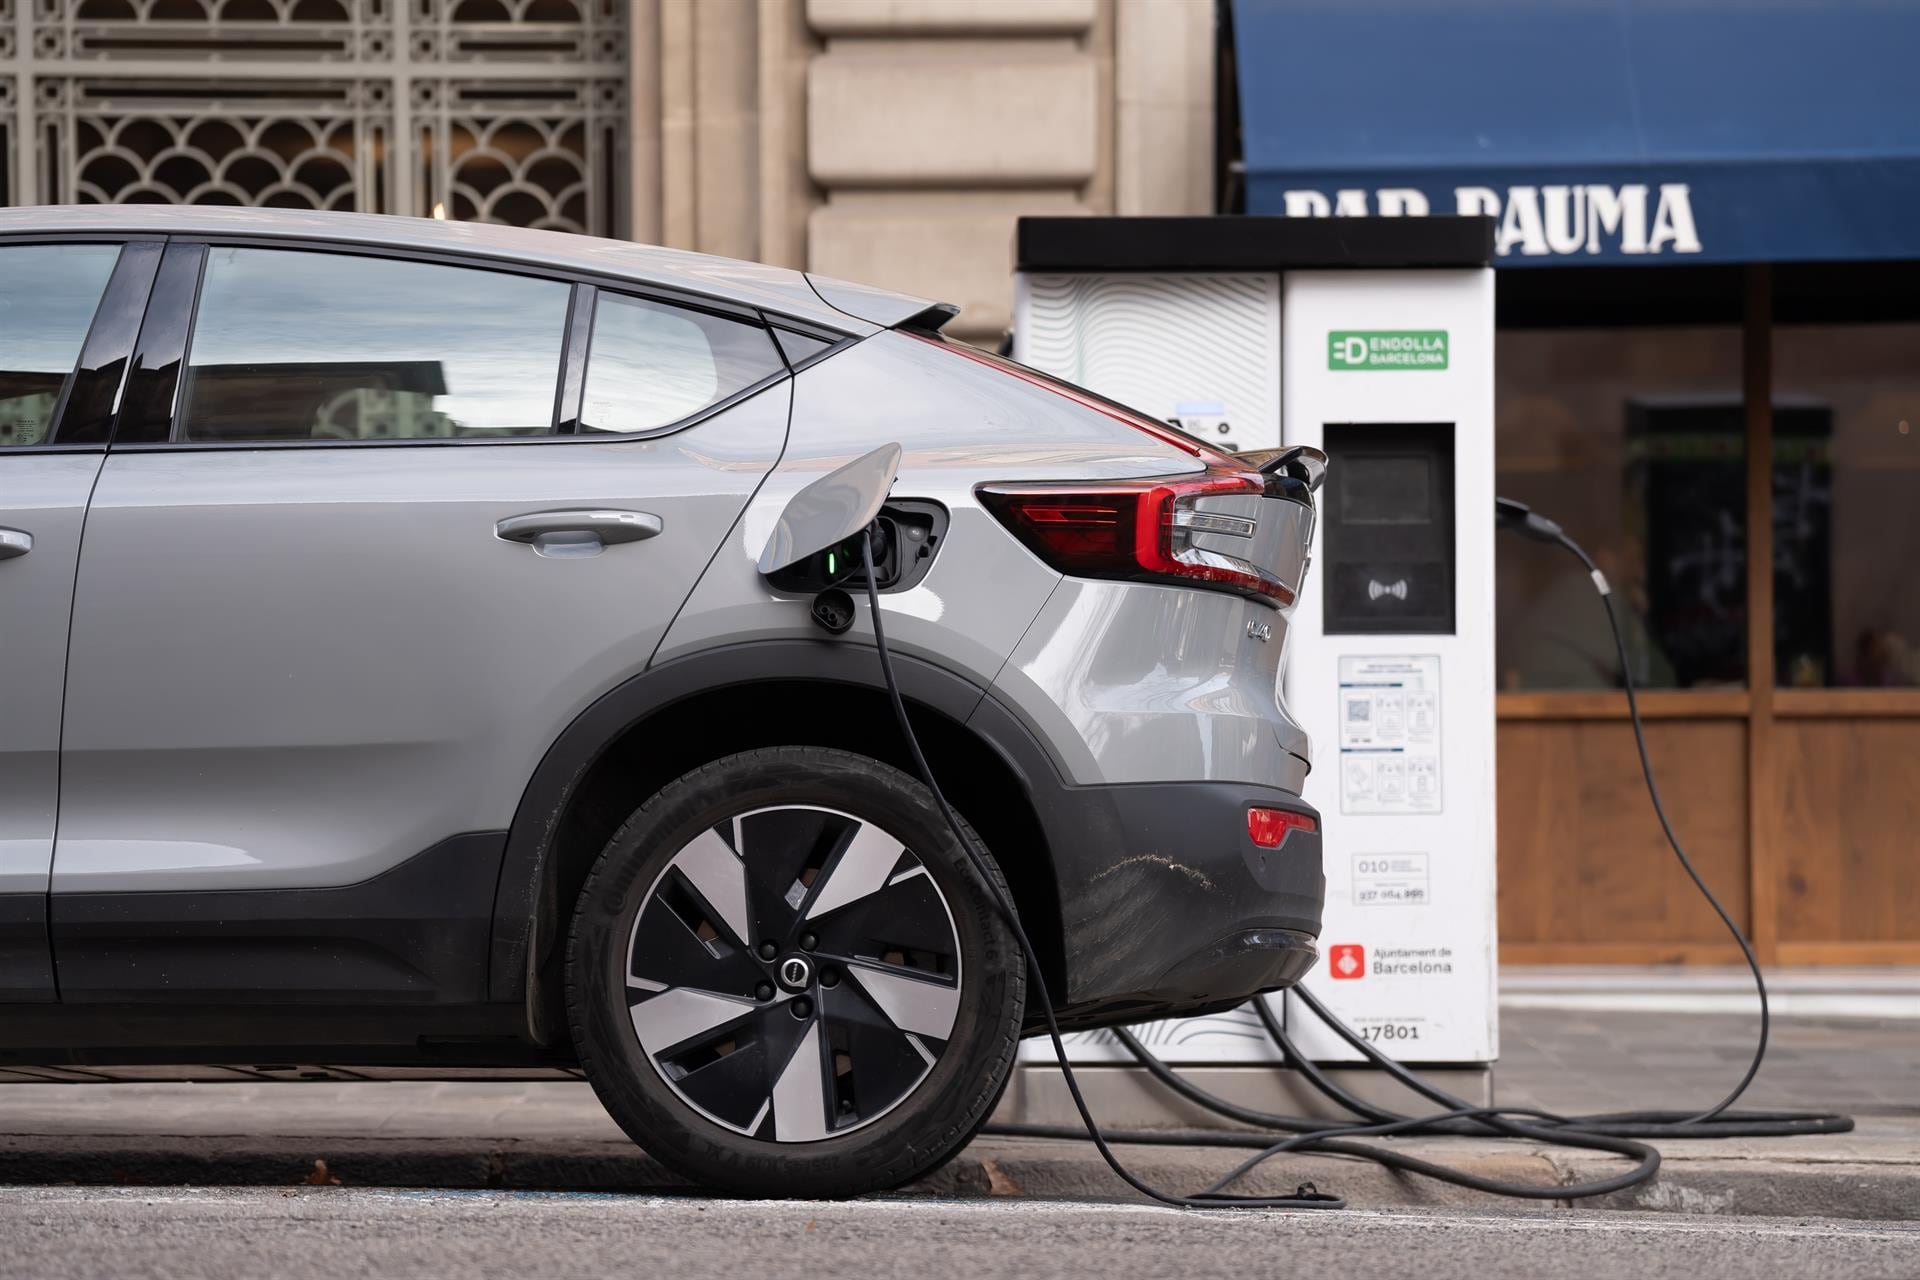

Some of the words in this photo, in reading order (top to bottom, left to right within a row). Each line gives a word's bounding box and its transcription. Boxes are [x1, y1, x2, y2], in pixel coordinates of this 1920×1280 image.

[1370, 337, 1443, 351] ENDOLLA
[1369, 353, 1444, 365] BARCELONA
[1359, 861, 1388, 873] 010
[1374, 949, 1436, 960] Ajuntament
[1439, 948, 1452, 957] de
[1373, 961, 1452, 975] Barcelona
[1361, 1024, 1419, 1041] 17801
